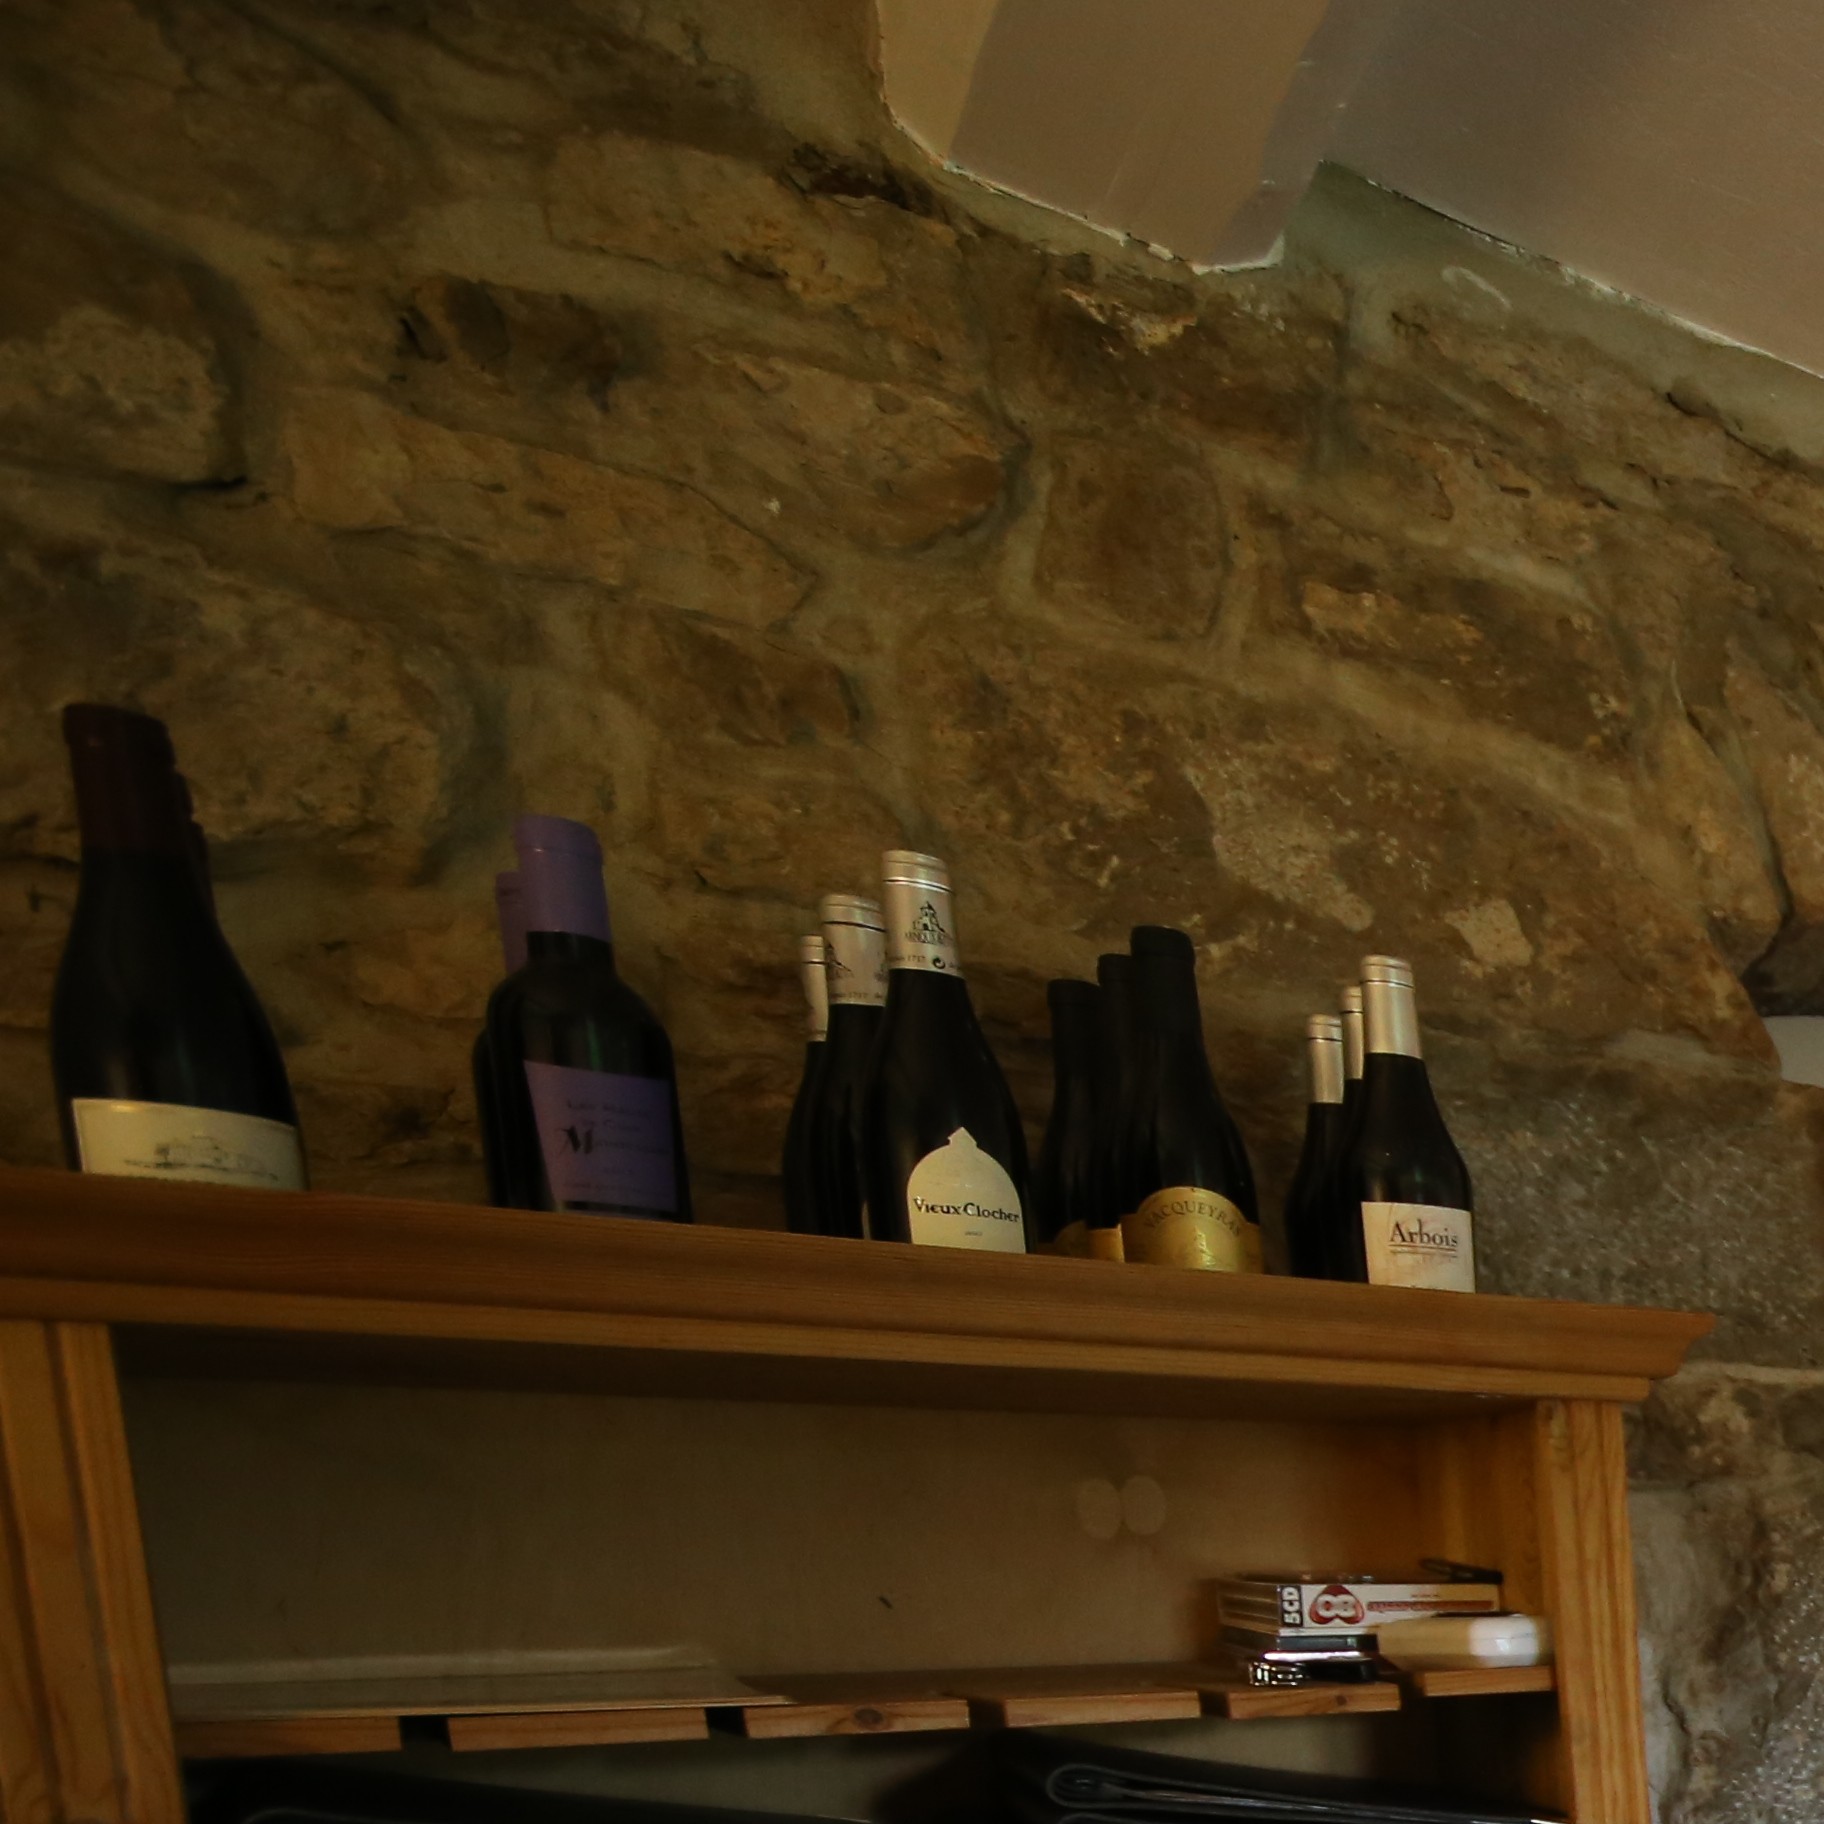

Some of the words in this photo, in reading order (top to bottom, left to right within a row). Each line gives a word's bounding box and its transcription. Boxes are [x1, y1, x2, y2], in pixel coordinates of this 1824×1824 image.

[912, 1198, 962, 1216] Vieux
[963, 1202, 1020, 1223] Clocher
[1144, 1200, 1241, 1236] VACQUEYRAS
[1388, 1218, 1458, 1248] Arbois
